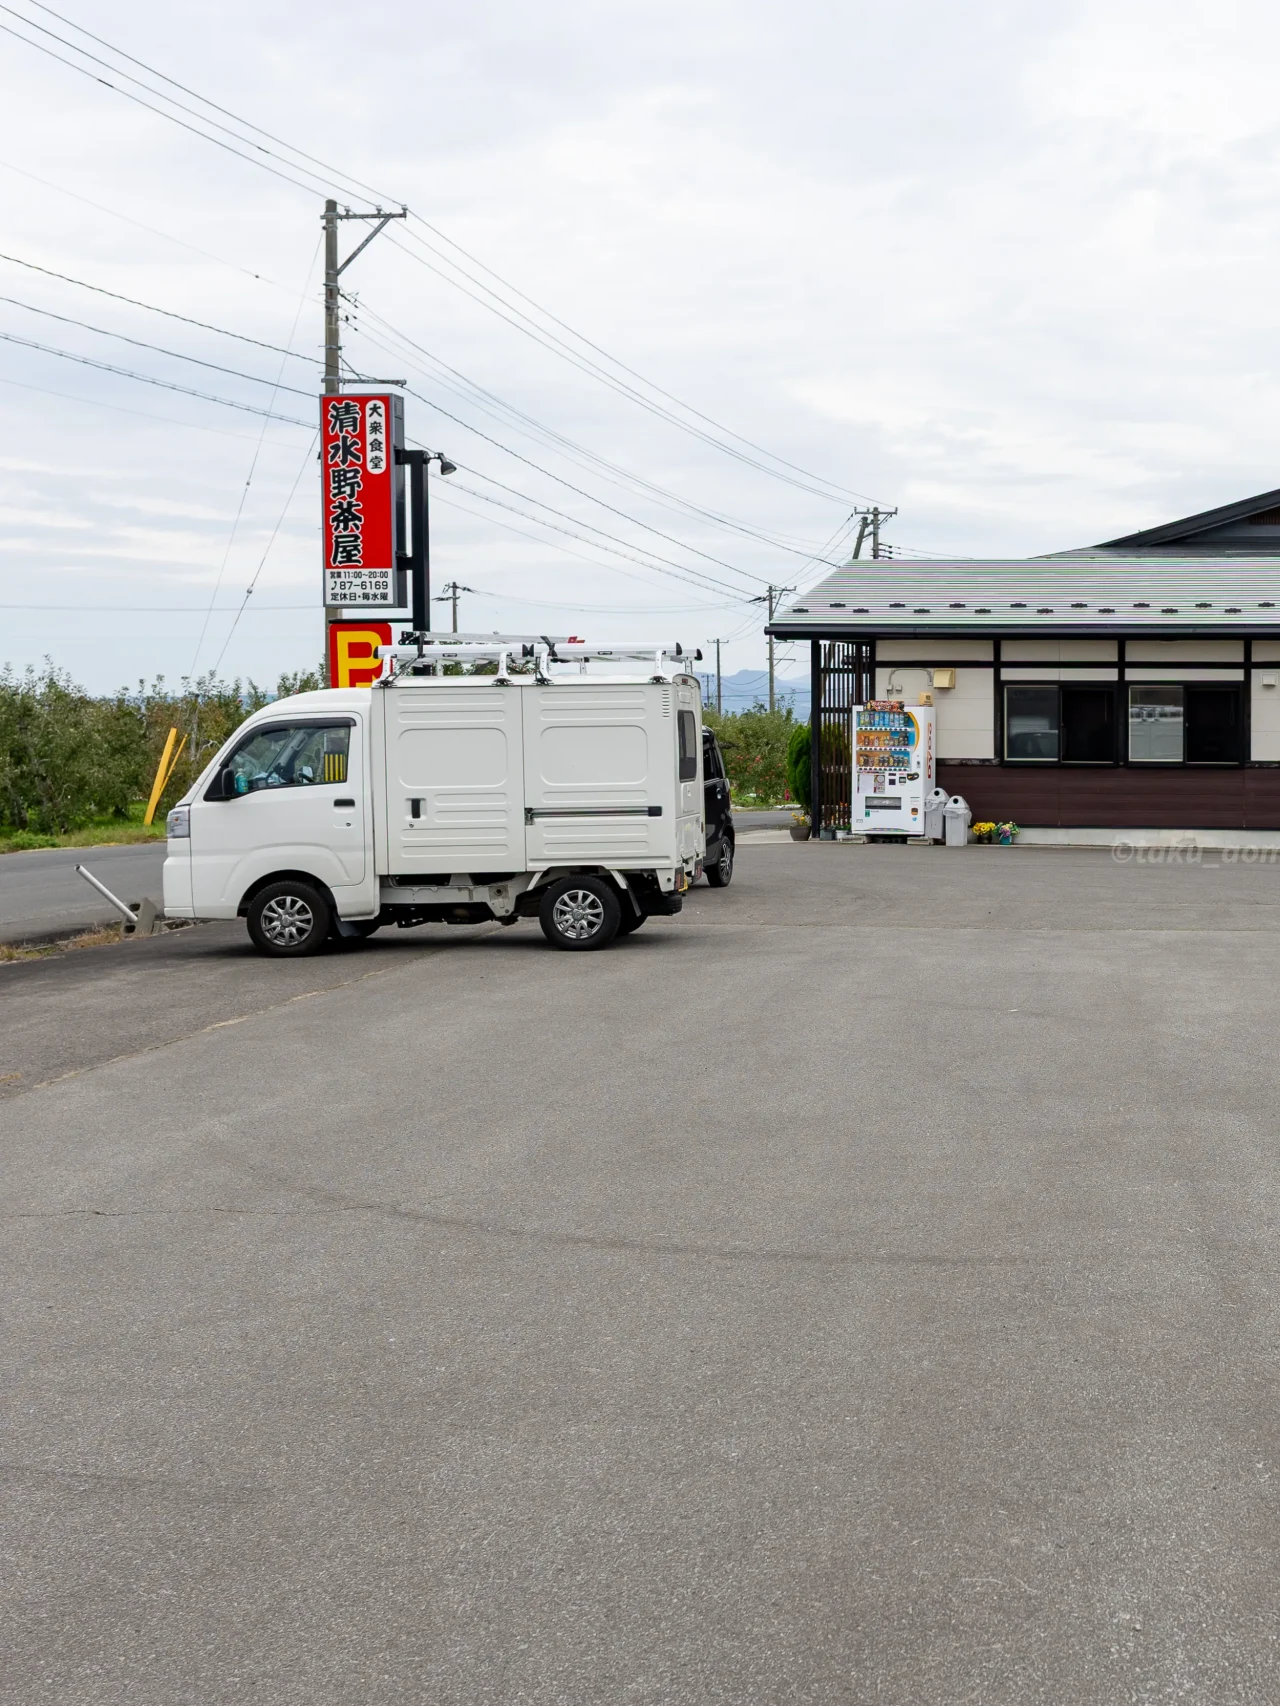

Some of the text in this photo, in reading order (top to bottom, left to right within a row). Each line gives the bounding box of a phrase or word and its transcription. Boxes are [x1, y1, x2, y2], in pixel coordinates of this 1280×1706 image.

[368, 402, 384, 470] 大衆食堂
[328, 400, 363, 567] 清水野茶屋
[339, 580, 389, 590] 87-6169
[336, 630, 383, 688] P
